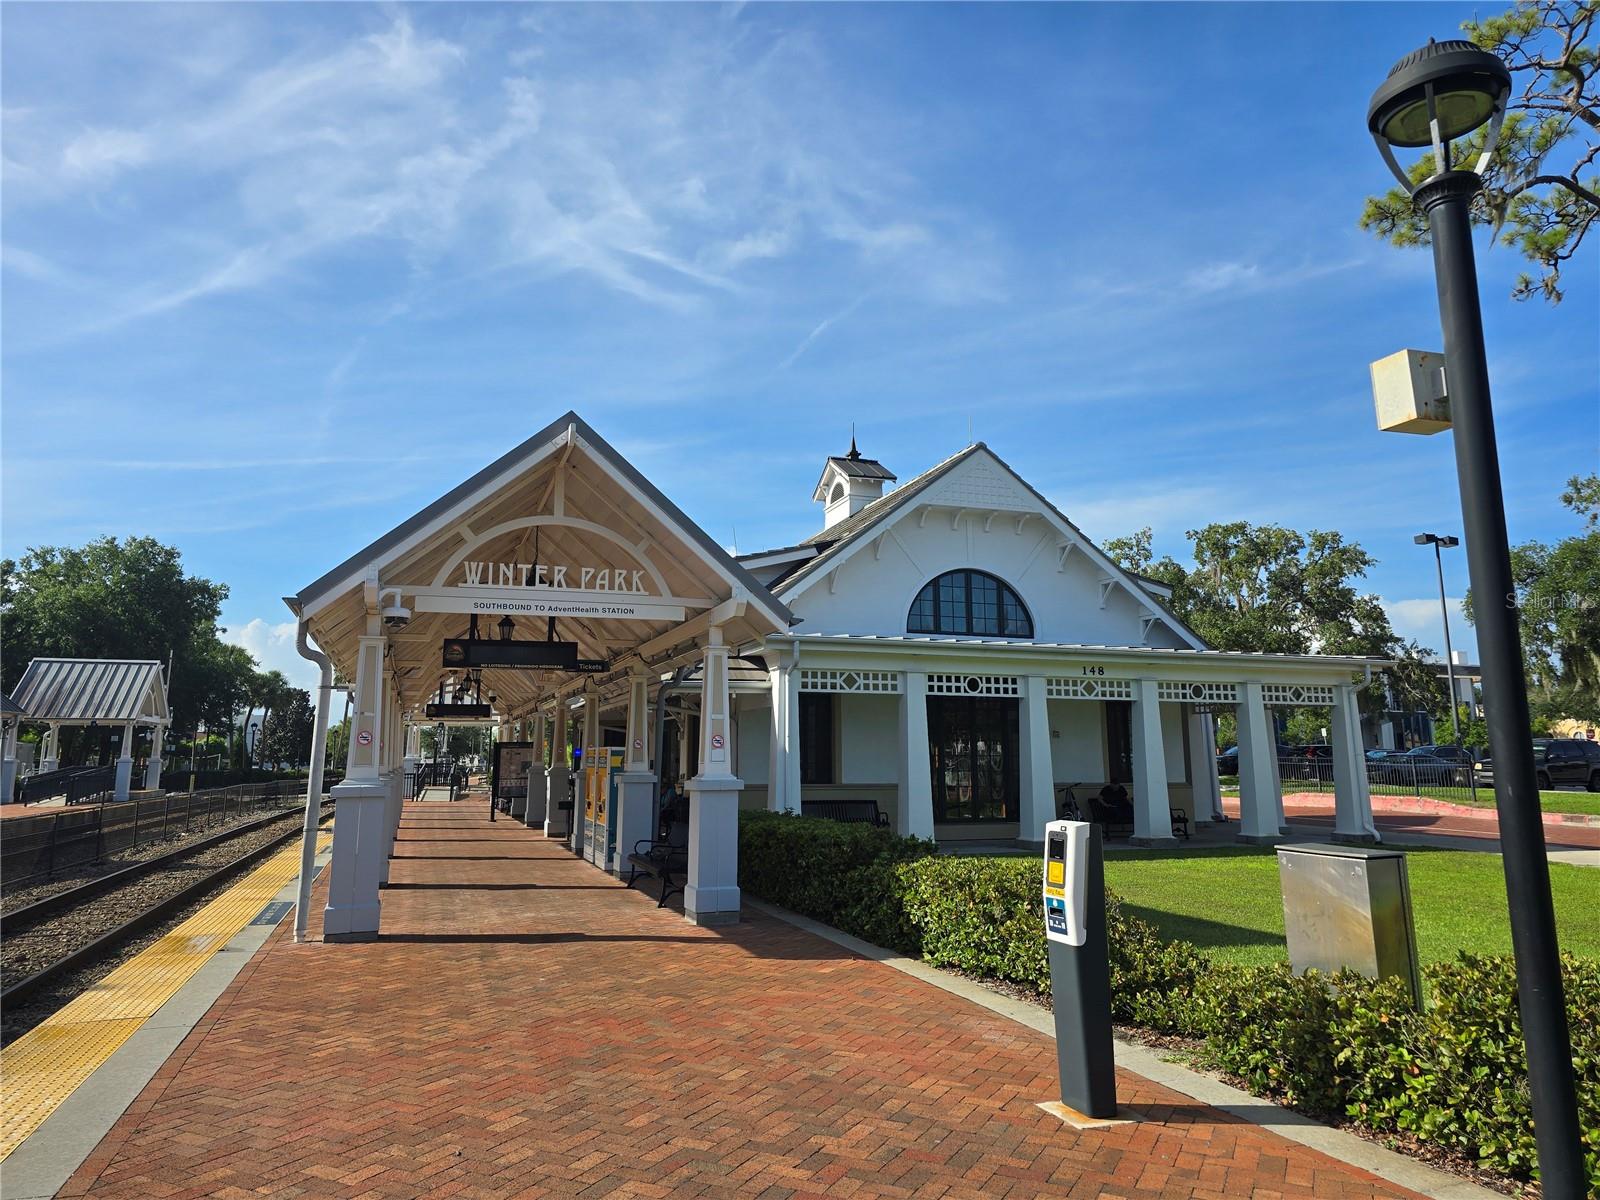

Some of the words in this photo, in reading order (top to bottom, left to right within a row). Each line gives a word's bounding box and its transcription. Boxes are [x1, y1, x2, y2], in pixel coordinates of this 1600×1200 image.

[464, 561, 568, 589] WINTER
[581, 567, 646, 593] PARK
[473, 602, 532, 611] SOUTHBOUND
[535, 604, 546, 612] TO
[548, 605, 599, 614] AdventHealth
[601, 607, 635, 615] STATION
[1082, 665, 1105, 676] 148
